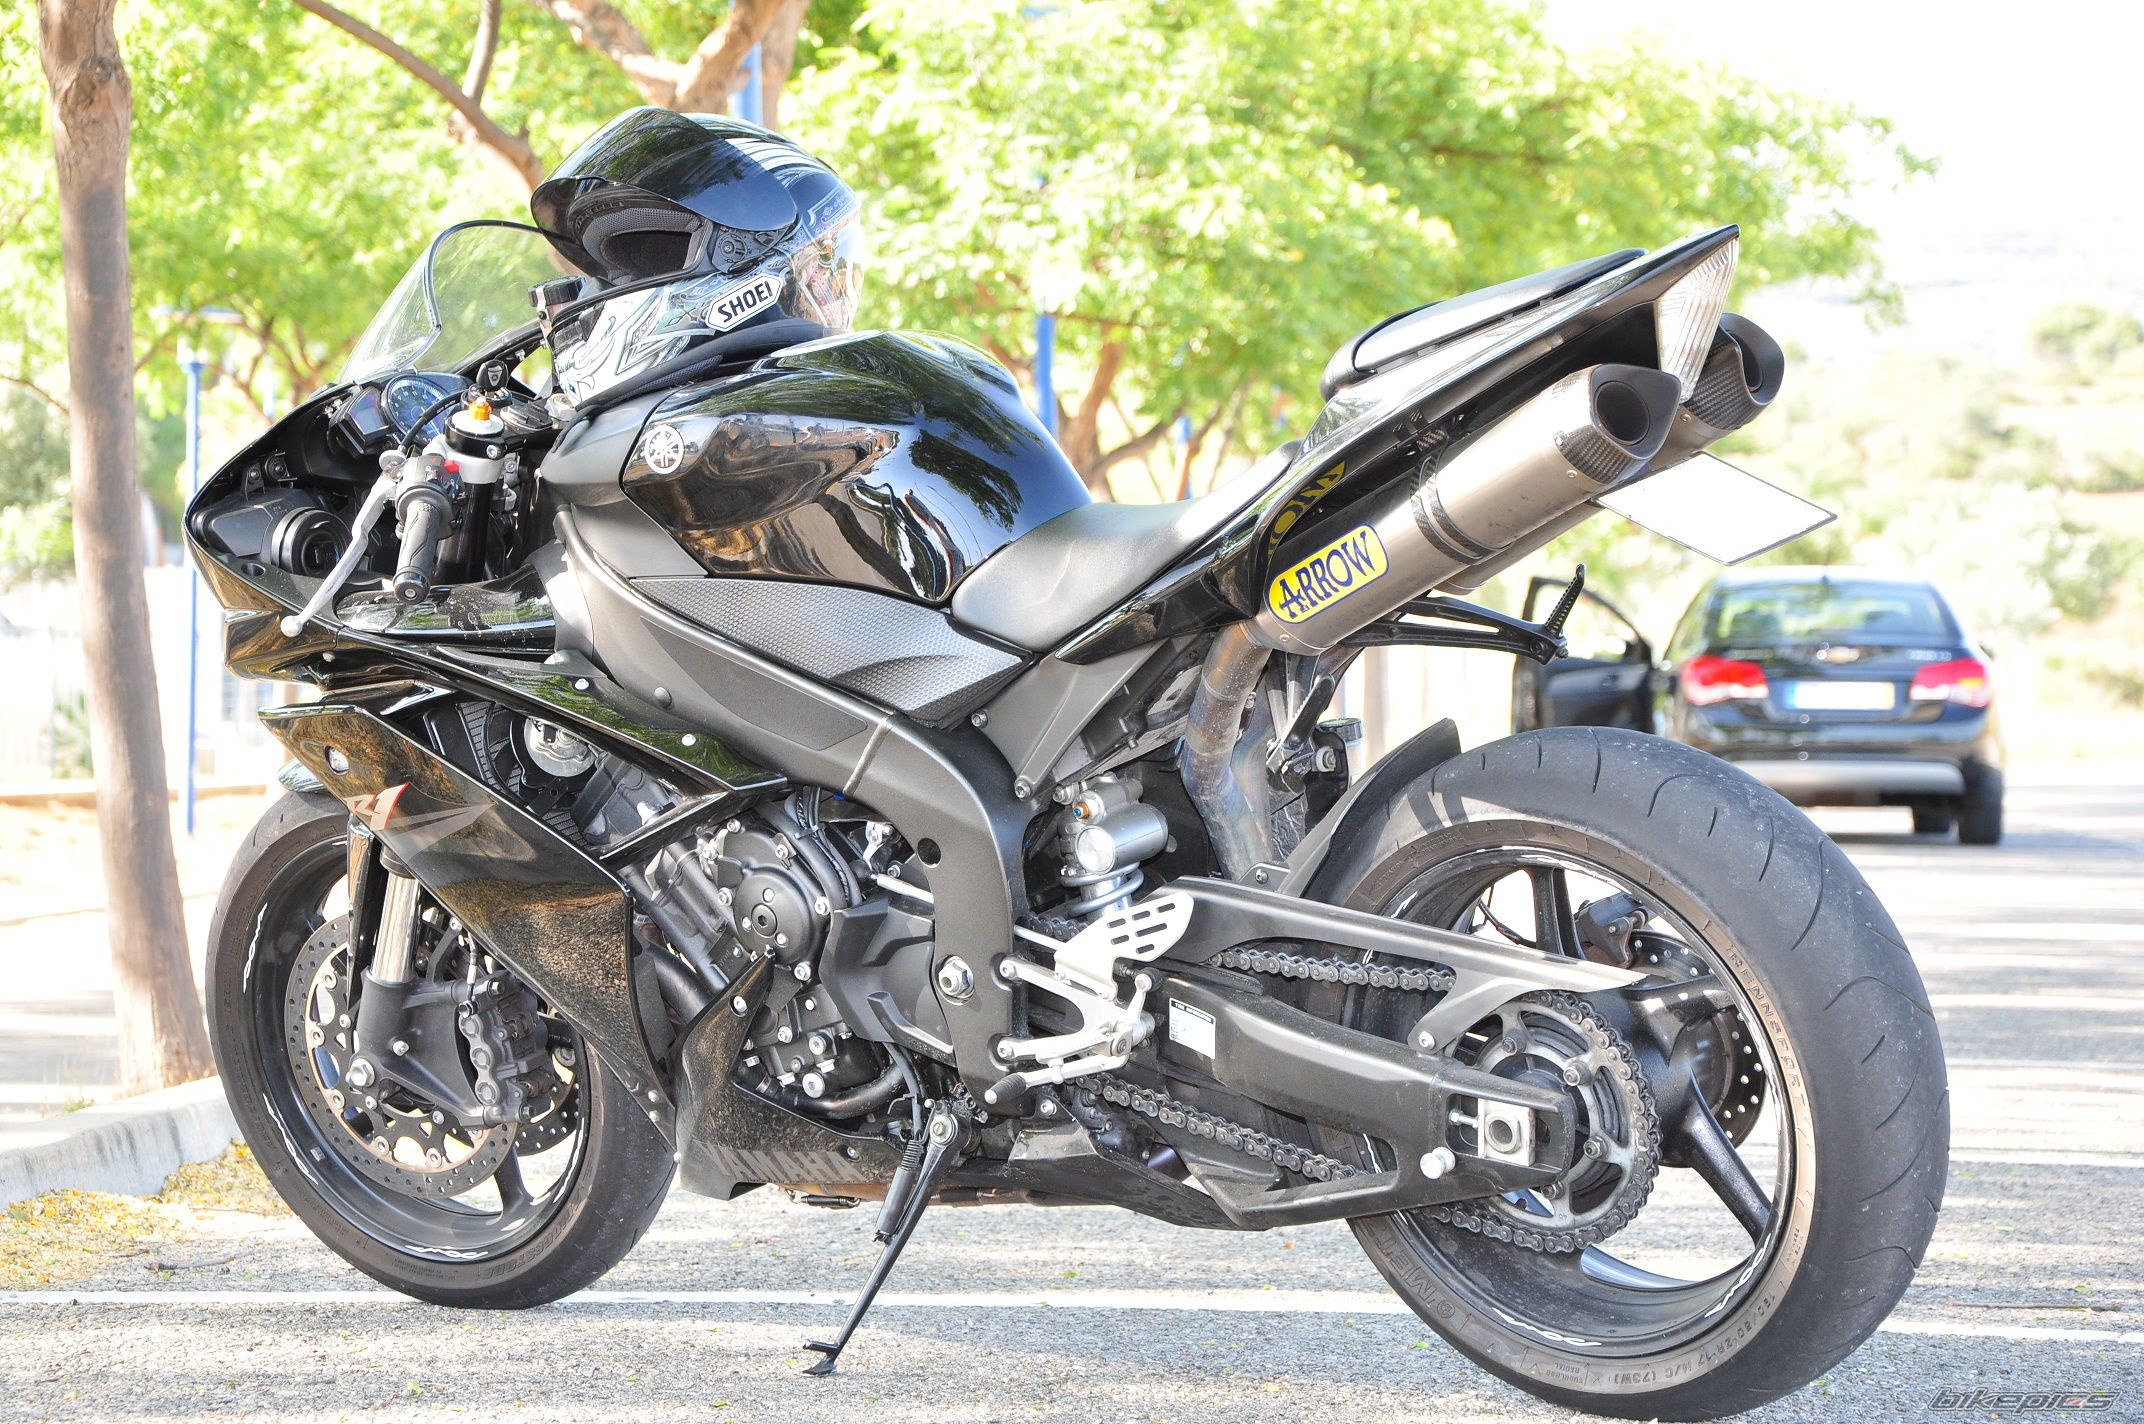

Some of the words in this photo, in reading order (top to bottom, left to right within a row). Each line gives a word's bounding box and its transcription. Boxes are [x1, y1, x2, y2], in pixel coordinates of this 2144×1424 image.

[718, 281, 773, 323] SHOEI
[1279, 530, 1375, 619] ARROW
[692, 1139, 867, 1182] YAMAHA
[1554, 1362, 1581, 1373] RADIAL
[1613, 1369, 1657, 1385] (73W)
